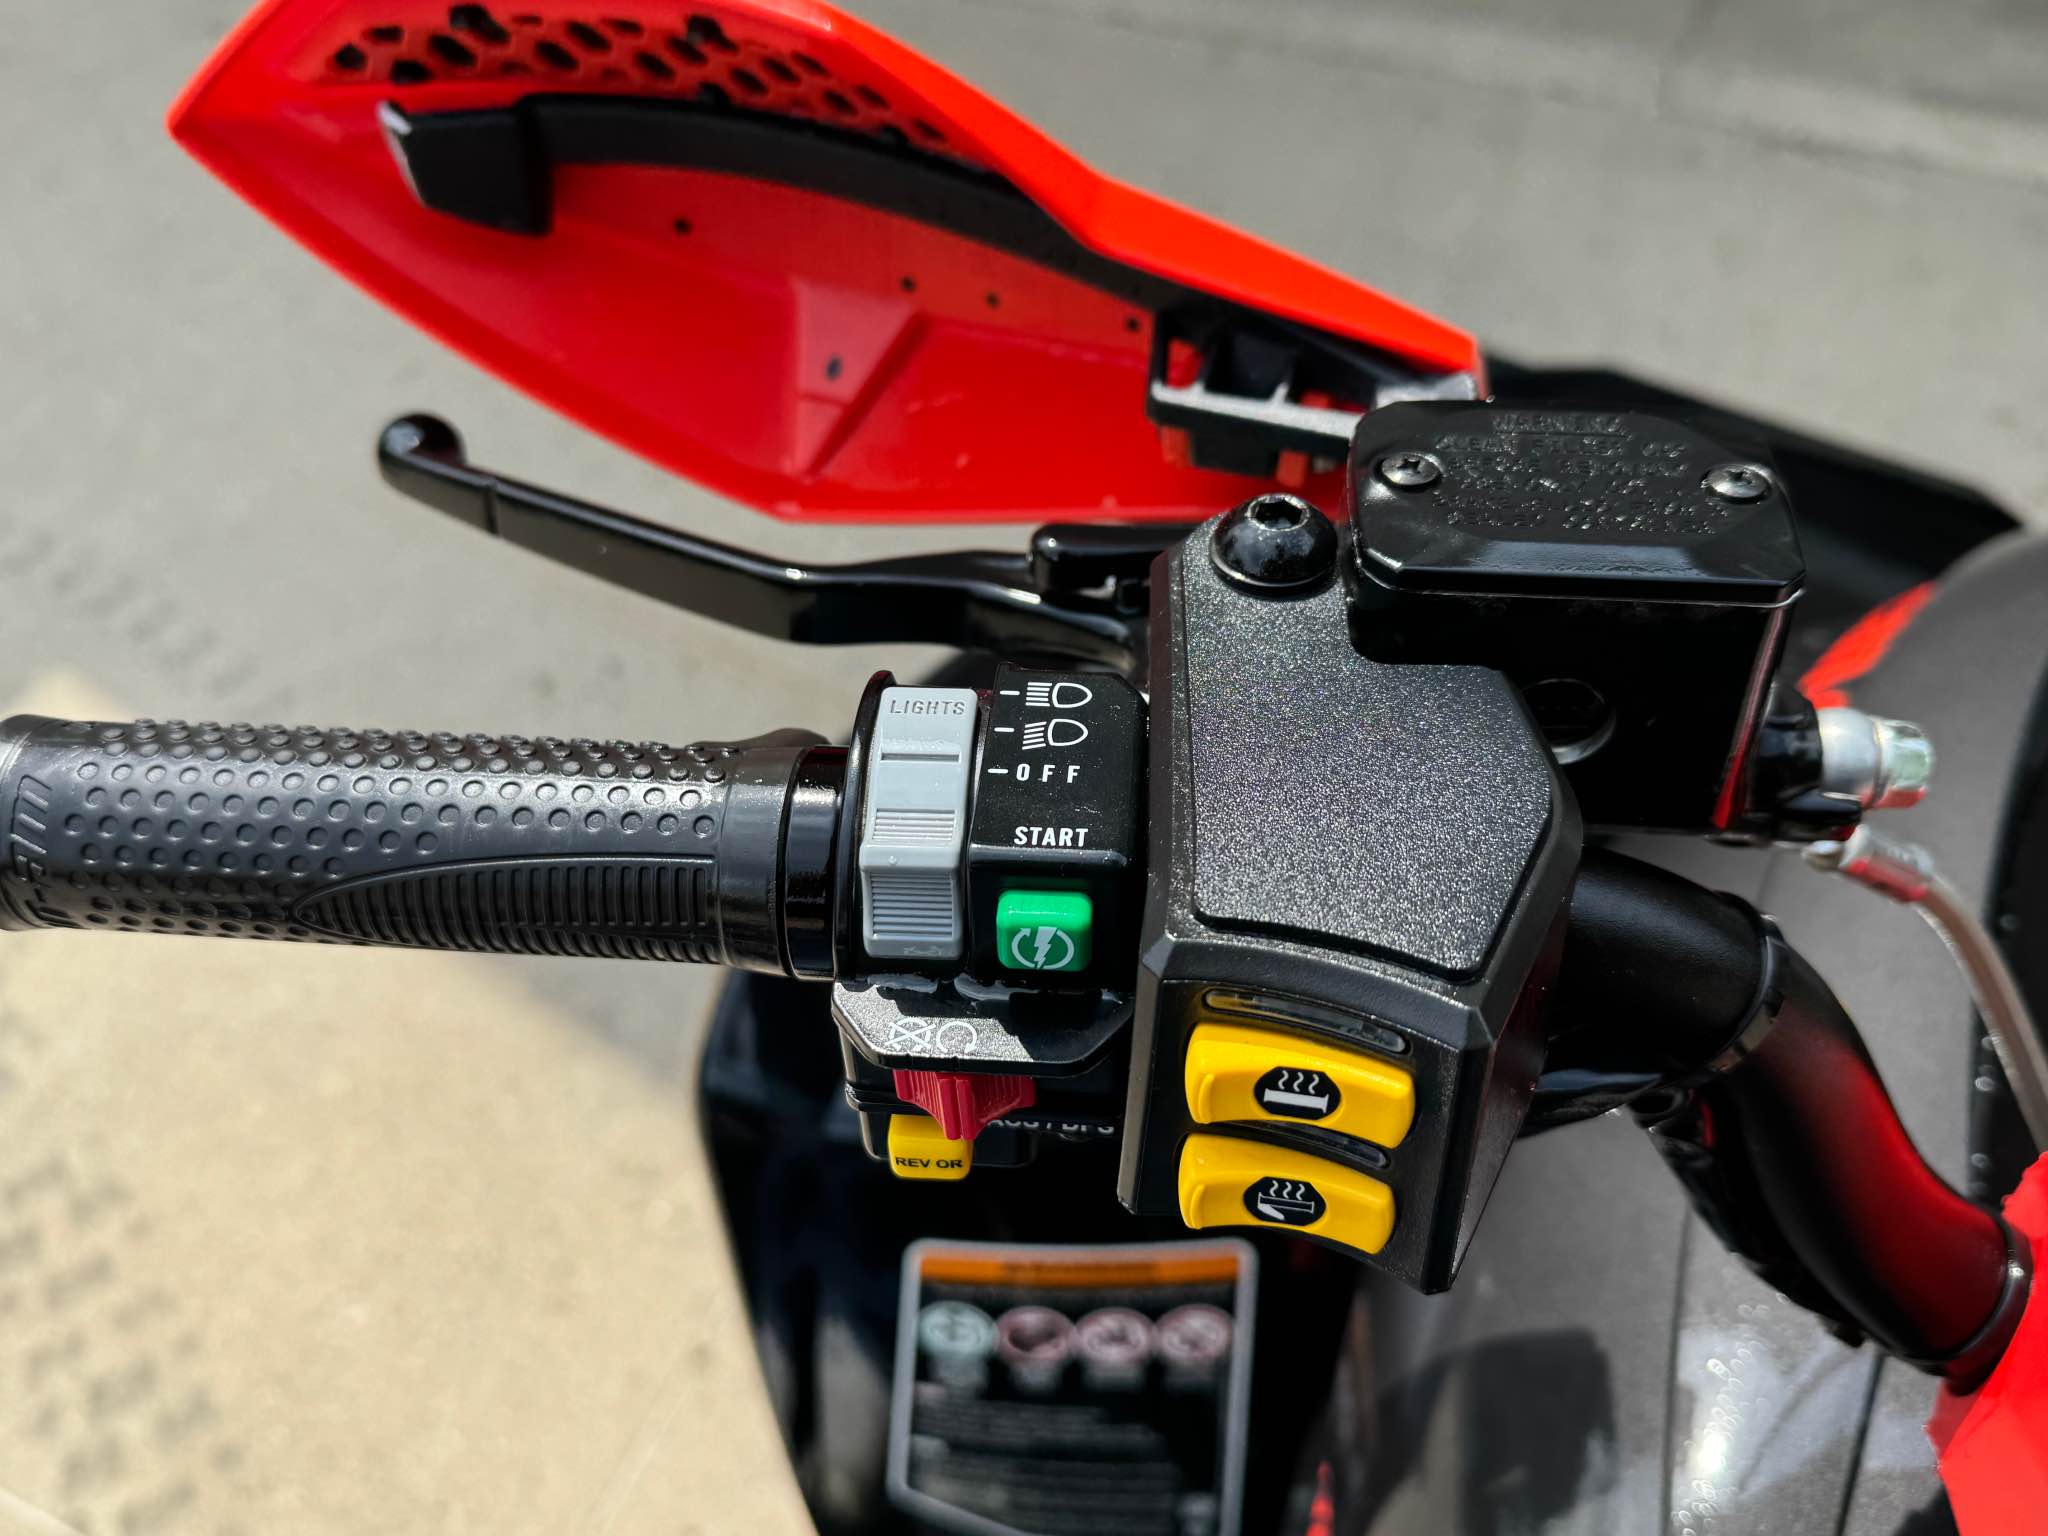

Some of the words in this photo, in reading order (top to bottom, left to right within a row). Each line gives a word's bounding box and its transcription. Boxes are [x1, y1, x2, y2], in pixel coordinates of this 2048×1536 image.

[890, 699, 965, 716] LIGHTS
[1013, 826, 1089, 848] START
[895, 1156, 930, 1170] REV
[936, 1159, 963, 1170] OR
